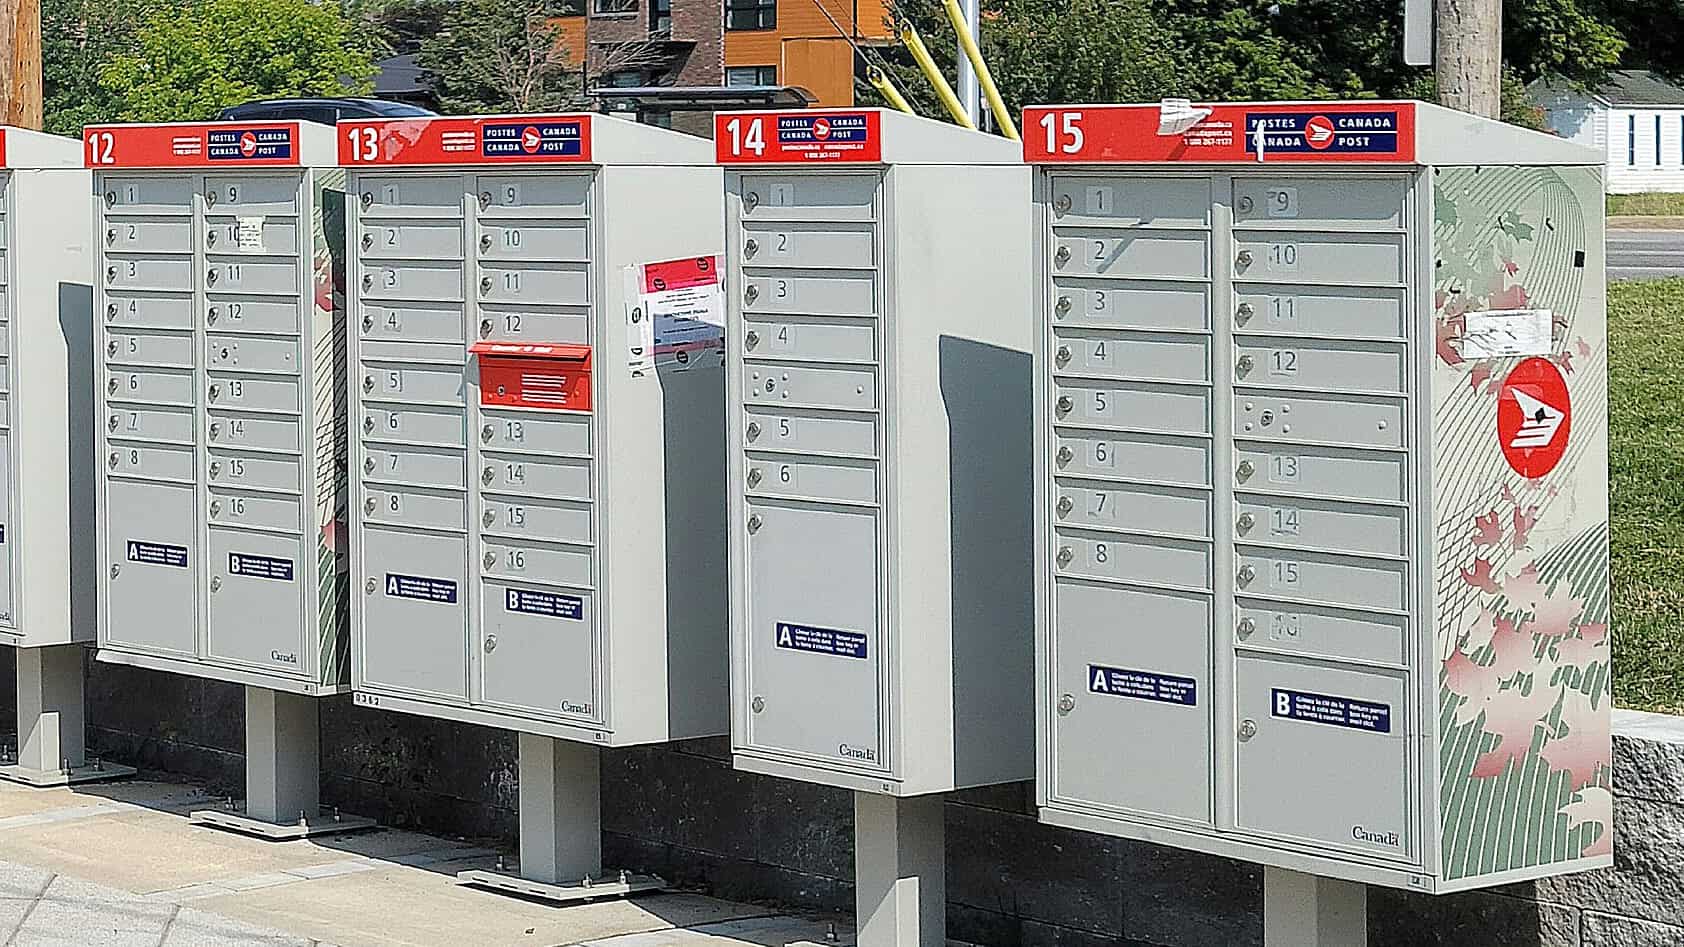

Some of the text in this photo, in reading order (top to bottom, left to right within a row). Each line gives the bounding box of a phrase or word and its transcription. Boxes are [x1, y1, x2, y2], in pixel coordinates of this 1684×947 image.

[781, 119, 807, 127] POSTES
[1339, 118, 1391, 127] CANADA
[211, 133, 287, 142] POSTES CANADA
[487, 128, 577, 137] POSTES CANADA
[727, 119, 766, 156] 14
[781, 131, 851, 139] CANADA POST
[1040, 112, 1083, 154] 15
[88, 132, 115, 164] 12
[348, 127, 378, 161] 13
[487, 143, 564, 152] CANADA POST
[1338, 137, 1370, 146] POST
[129, 188, 133, 202] 1
[229, 187, 236, 202] 9
[389, 188, 394, 203] 1
[507, 188, 515, 203] 9
[779, 188, 784, 204] 1
[1096, 191, 1104, 209] 1
[1277, 191, 1288, 211] 9
[129, 226, 135, 240] 2
[228, 226, 239, 241] 10
[388, 230, 395, 245] 2
[505, 230, 520, 246] 10
[778, 234, 786, 251] 2
[1094, 241, 1105, 259] 2
[1273, 245, 1296, 265] 10
[129, 262, 136, 277] 3
[228, 265, 240, 280] 11
[389, 270, 396, 286] 3
[505, 273, 519, 289] 11
[777, 281, 786, 297] 3
[129, 300, 136, 314] 4
[1094, 292, 1105, 311] 3
[1273, 299, 1294, 318] 11
[229, 304, 241, 319] 12
[388, 313, 396, 328] 4
[505, 316, 521, 332] 12
[778, 327, 787, 344] 4
[130, 338, 136, 352] 5
[1094, 342, 1106, 360] 4
[1274, 352, 1296, 371] 12
[130, 375, 137, 389] 6
[390, 373, 397, 388] 5
[229, 382, 242, 397] 13
[1096, 393, 1105, 411] 5
[130, 413, 137, 427] 7
[390, 413, 397, 428] 6
[780, 419, 789, 436] 5
[230, 421, 243, 436] 14
[507, 422, 522, 438] 13
[131, 450, 138, 464] 8
[1096, 443, 1106, 462] 6
[231, 460, 243, 475] 15
[391, 455, 397, 470] 7
[1274, 457, 1297, 477] 13
[507, 465, 523, 481] 14
[780, 466, 789, 482] 6
[232, 499, 244, 514] 16
[390, 495, 399, 511] 8
[1097, 494, 1106, 512] 7
[508, 508, 524, 524] 15
[1275, 510, 1298, 530] 14
[130, 543, 138, 560] A
[1097, 544, 1106, 563] 8
[232, 556, 240, 573] B
[509, 552, 524, 568] 16
[1275, 563, 1297, 583] 15
[388, 577, 399, 595] A
[509, 591, 519, 609] B
[779, 626, 792, 647] A
[271, 649, 297, 664] Canada
[1092, 670, 1108, 691] A
[561, 701, 591, 714] Canada
[1276, 693, 1290, 715] B
[839, 744, 875, 761] Canada
[1352, 826, 1399, 847] Canada
